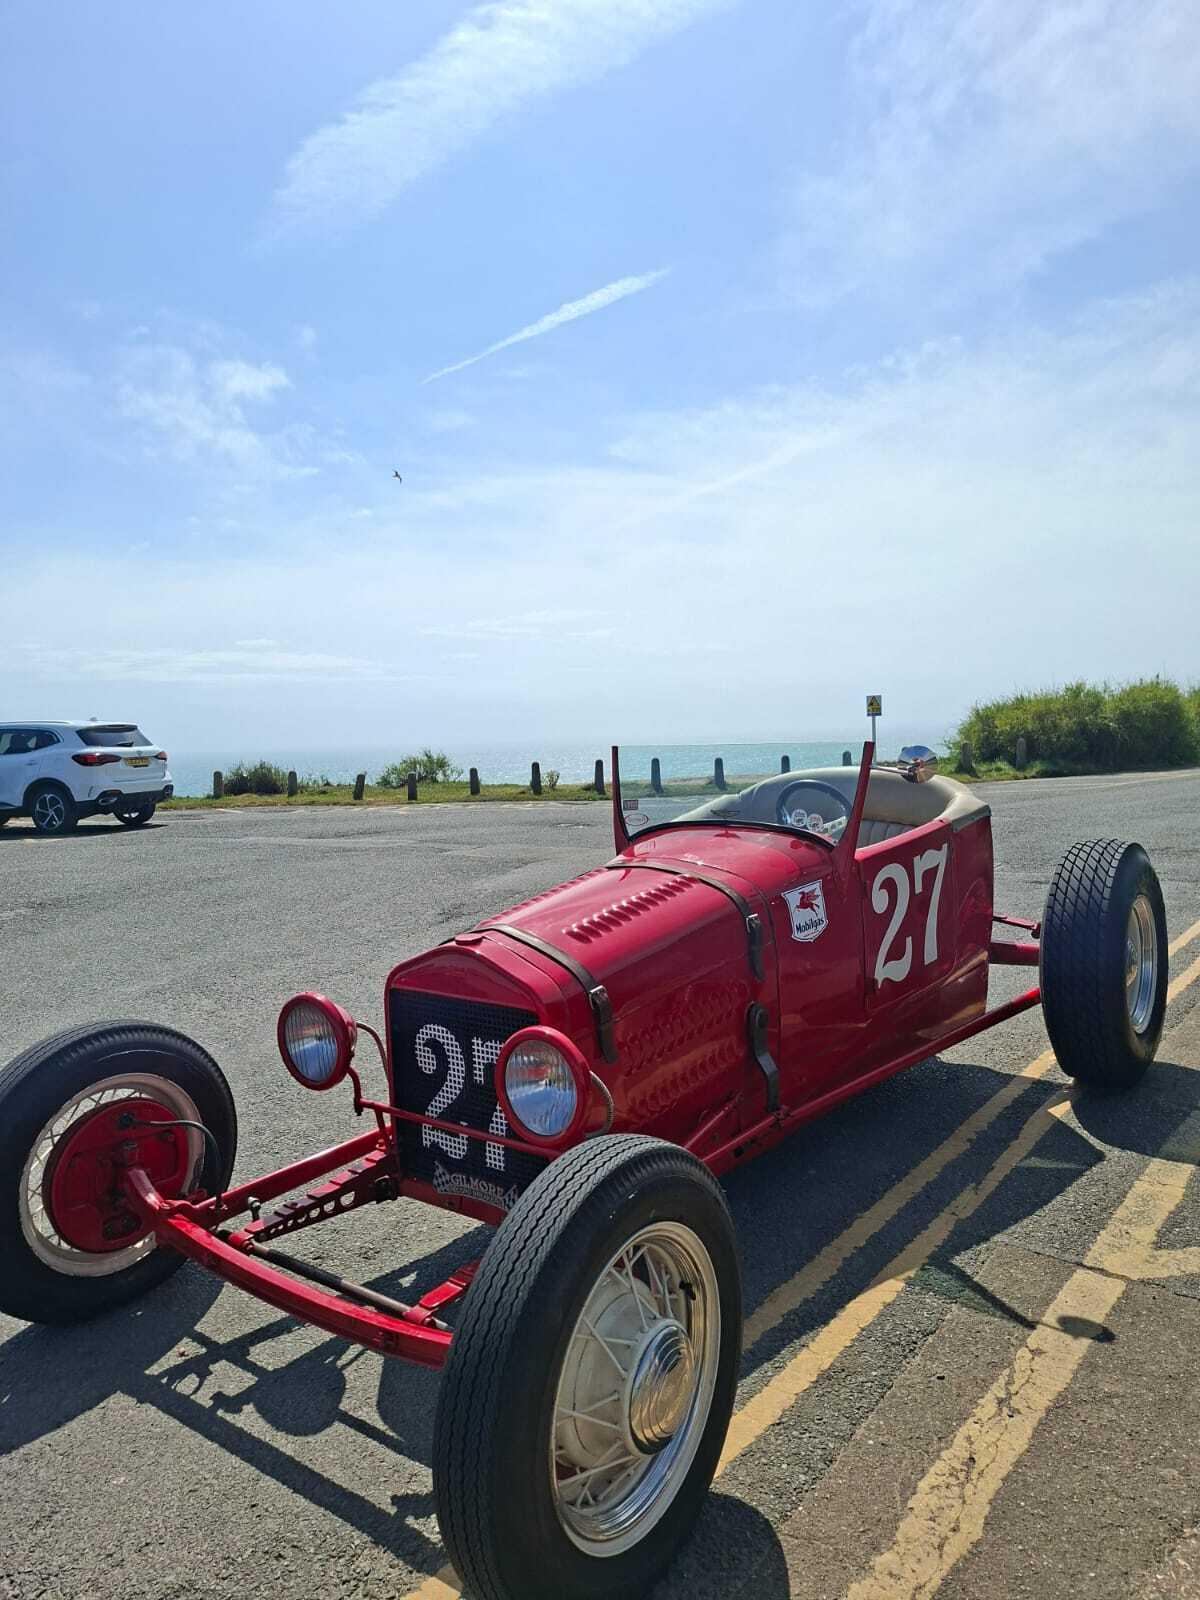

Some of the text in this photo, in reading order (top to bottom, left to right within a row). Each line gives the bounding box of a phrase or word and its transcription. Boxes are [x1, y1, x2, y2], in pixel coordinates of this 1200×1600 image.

[795, 917, 825, 934] Mobilgas
[872, 843, 948, 988] 27
[415, 1024, 507, 1171] 27
[450, 1173, 504, 1199] GILMORE
